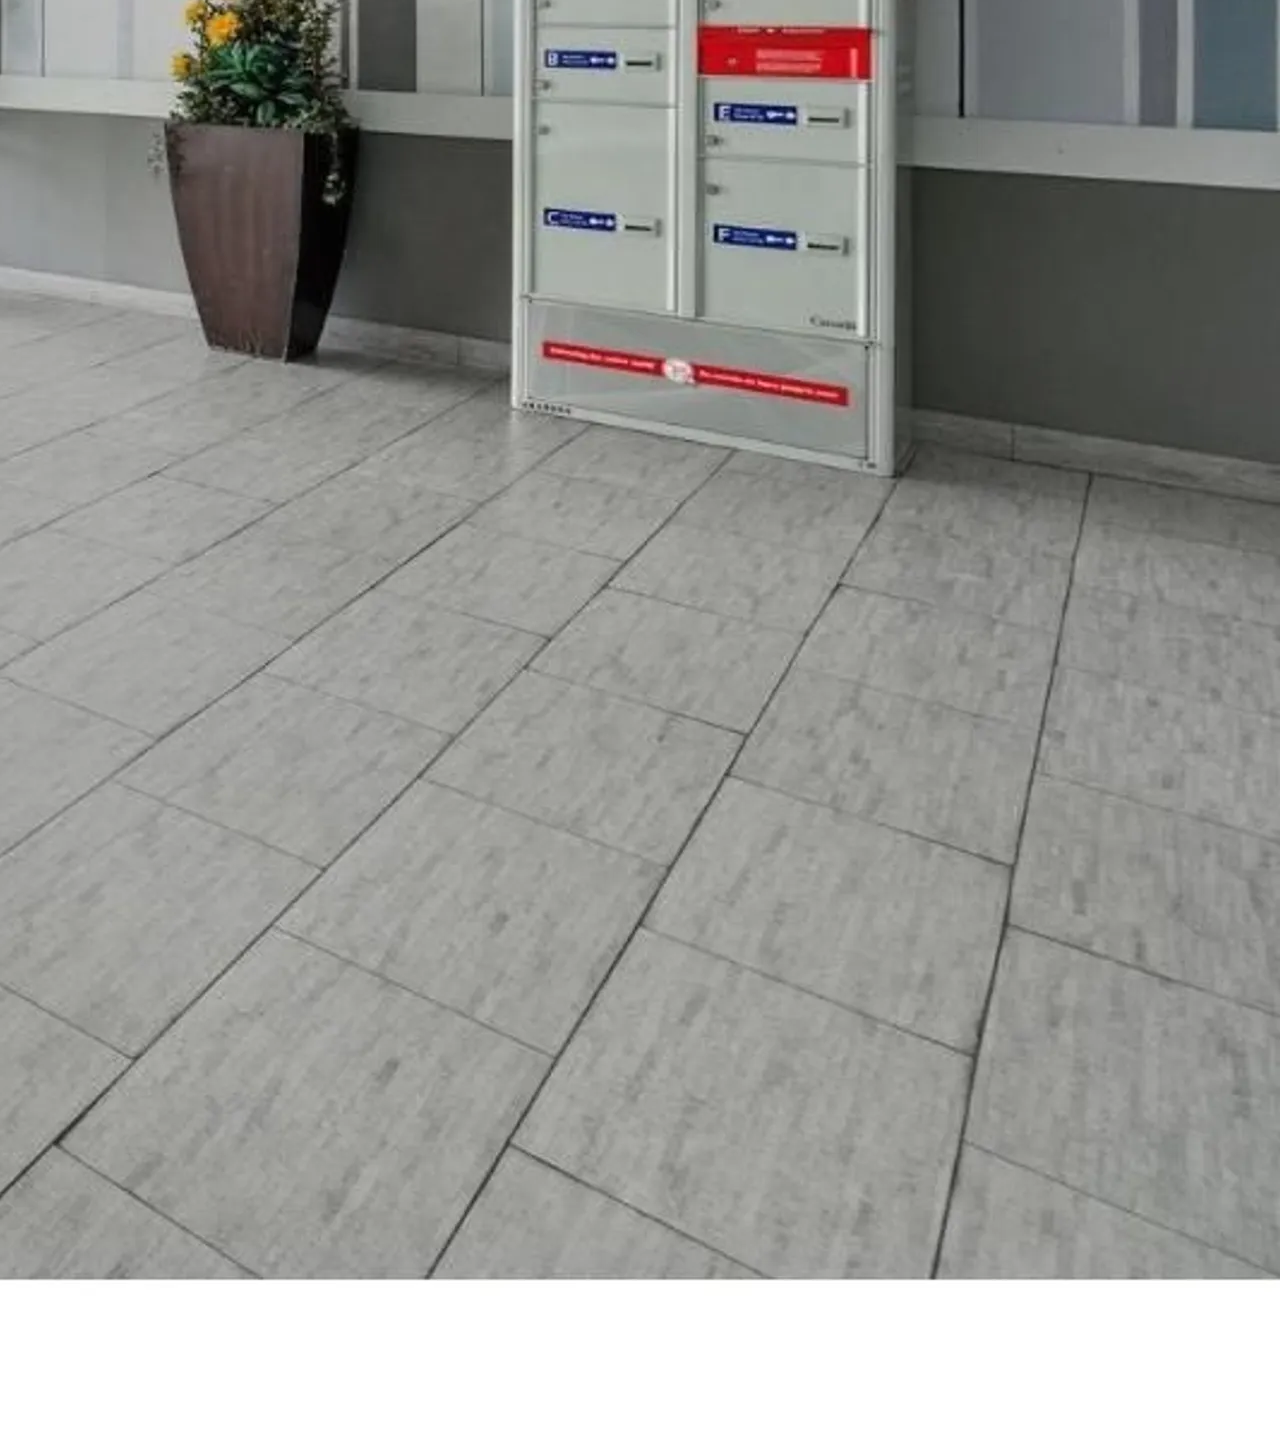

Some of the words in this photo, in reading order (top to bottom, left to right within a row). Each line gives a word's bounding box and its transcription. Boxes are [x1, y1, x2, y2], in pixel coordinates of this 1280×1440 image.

[548, 52, 559, 66] B
[547, 211, 559, 225] C
[718, 228, 731, 242] F
